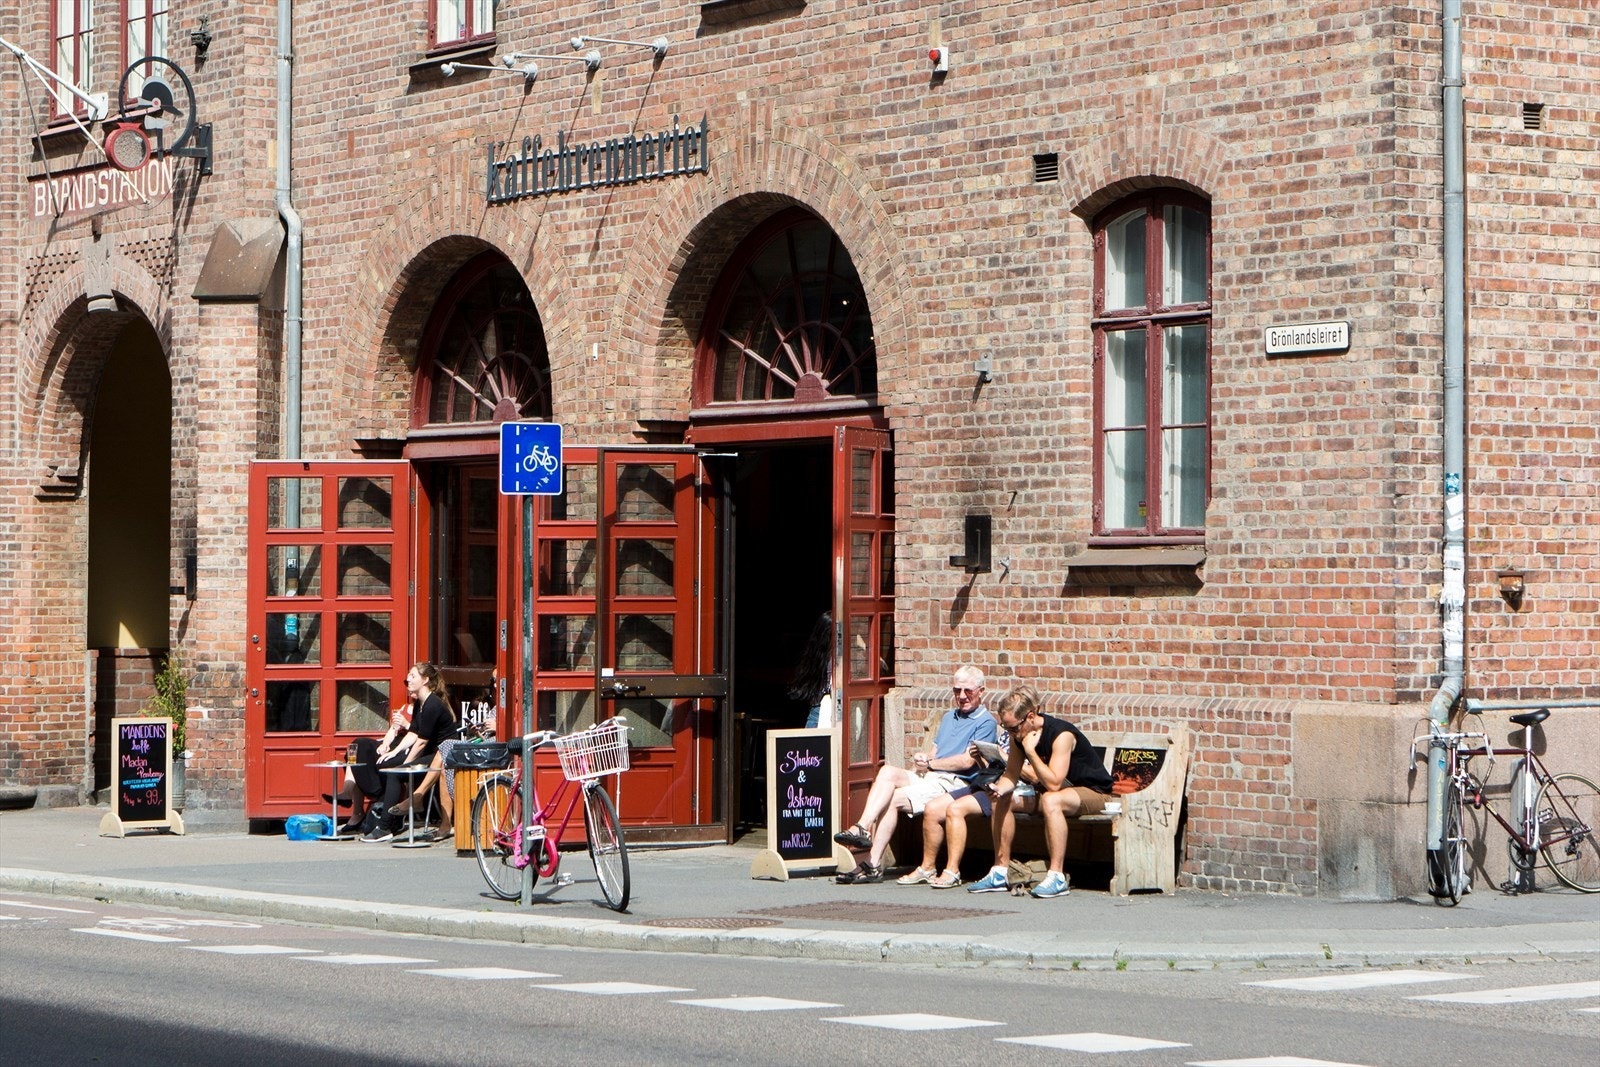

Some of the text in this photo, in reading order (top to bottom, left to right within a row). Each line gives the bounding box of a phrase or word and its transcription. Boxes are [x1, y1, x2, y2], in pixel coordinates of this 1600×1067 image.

[487, 110, 708, 200] kaffebrenneriet
[1271, 327, 1342, 347] Grönlandsleiret
[780, 749, 823, 773] Shakes
[797, 770, 807, 783] &
